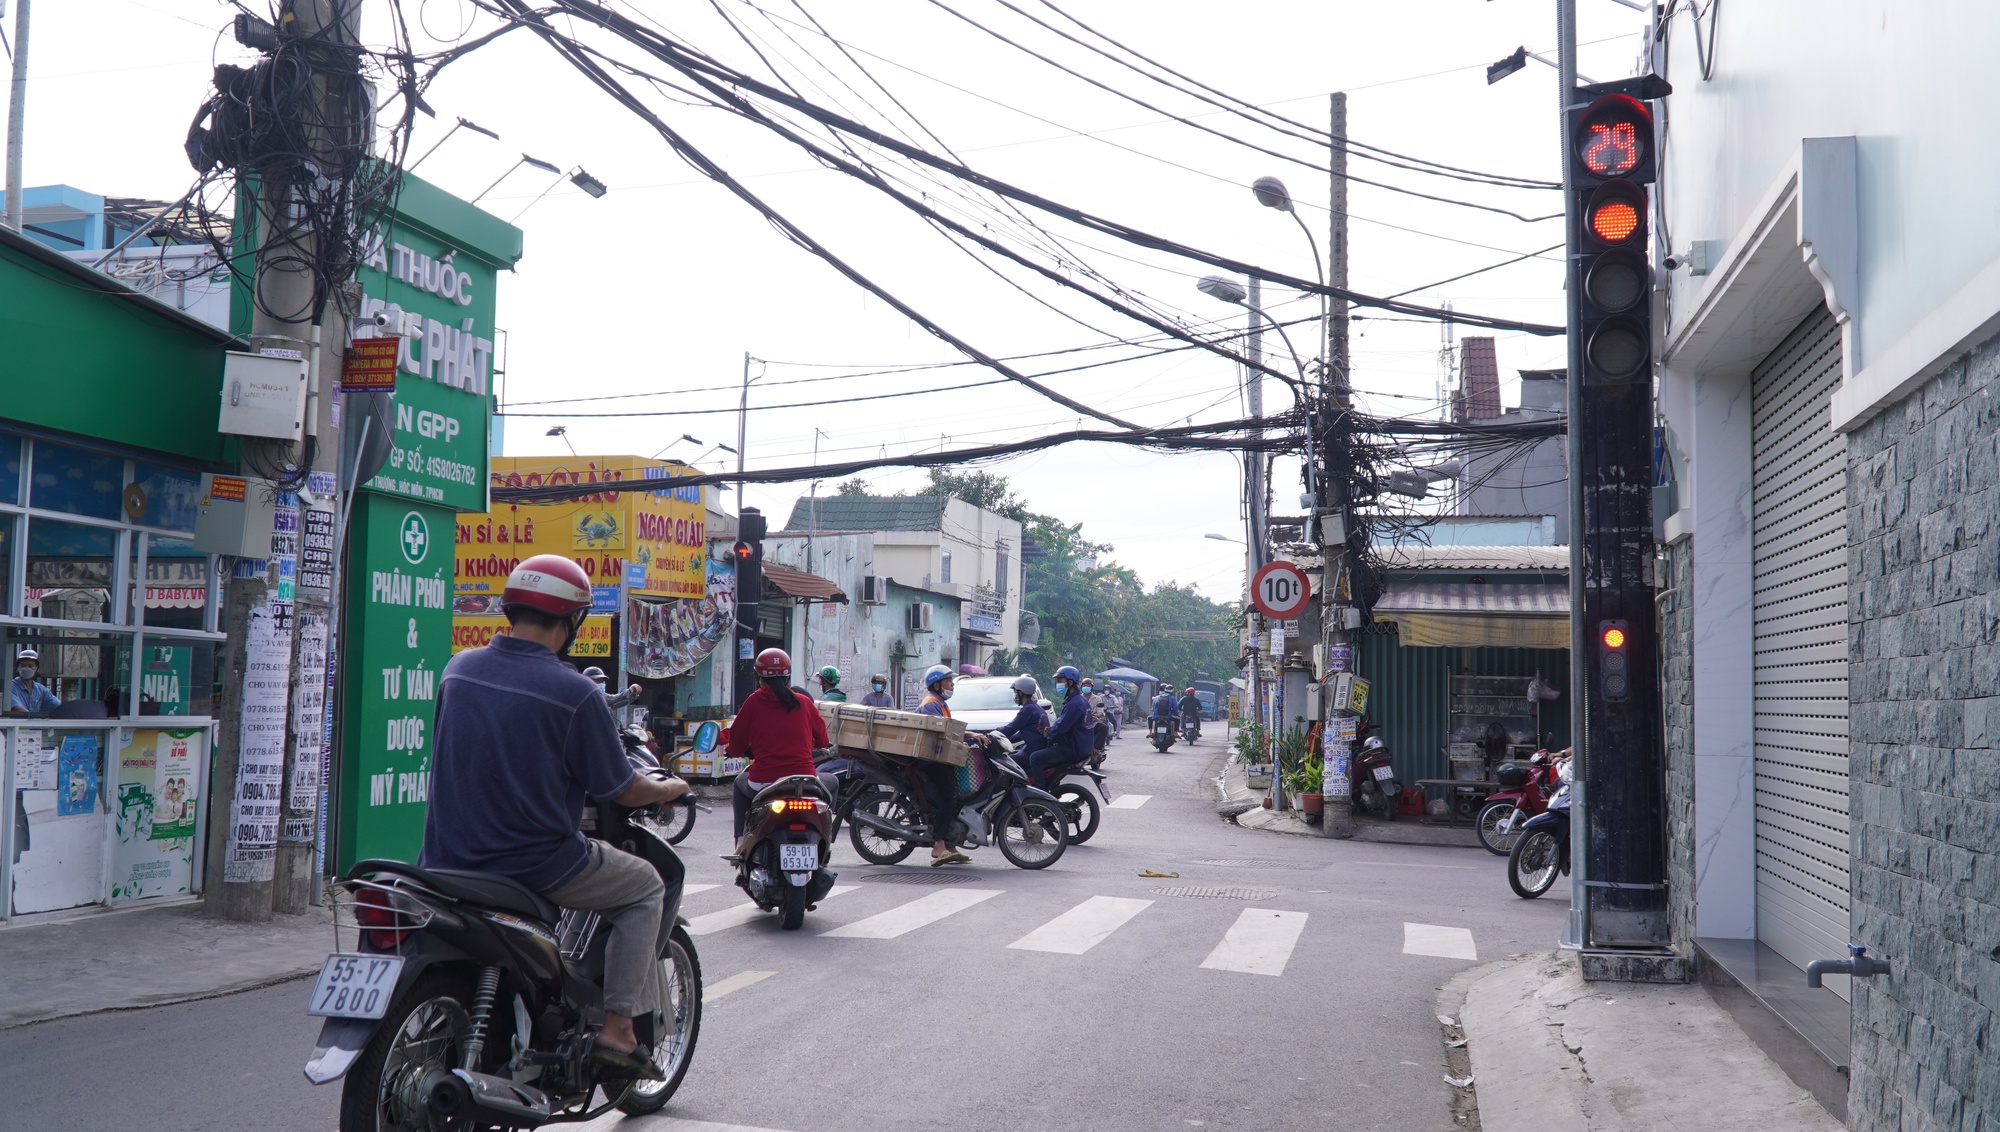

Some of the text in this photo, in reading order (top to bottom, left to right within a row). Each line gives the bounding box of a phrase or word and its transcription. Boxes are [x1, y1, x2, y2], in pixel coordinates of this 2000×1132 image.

[1588, 122, 1636, 170] 29
[392, 243, 472, 306] THUỐC
[421, 318, 492, 396] PHÁT
[417, 410, 459, 442] GPP
[391, 449, 405, 469] GP
[407, 445, 424, 474] SỐ:
[497, 525, 509, 543] &
[514, 517, 534, 543] LẺ
[637, 512, 704, 549] NGỌC GIÀU
[372, 567, 446, 609] PHÂN PHỐI
[407, 618, 418, 648] &
[575, 643, 608, 654] 150 790
[144, 669, 180, 703] NHÀ
[382, 658, 434, 700] TƯ VẤN
[247, 724, 264, 732] CHO
[387, 716, 424, 755] DƯỢC
[245, 764, 258, 774] CHO
[259, 765, 269, 774] VAY
[370, 756, 429, 807] MỸ PHẨ
[240, 805, 253, 815] CHO
[293, 796, 309, 807] 0987
[783, 858, 815, 869] 853.47
[786, 846, 811, 857] 59-D1
[331, 958, 391, 985] 55-Y7
[319, 985, 380, 1013] 7800
